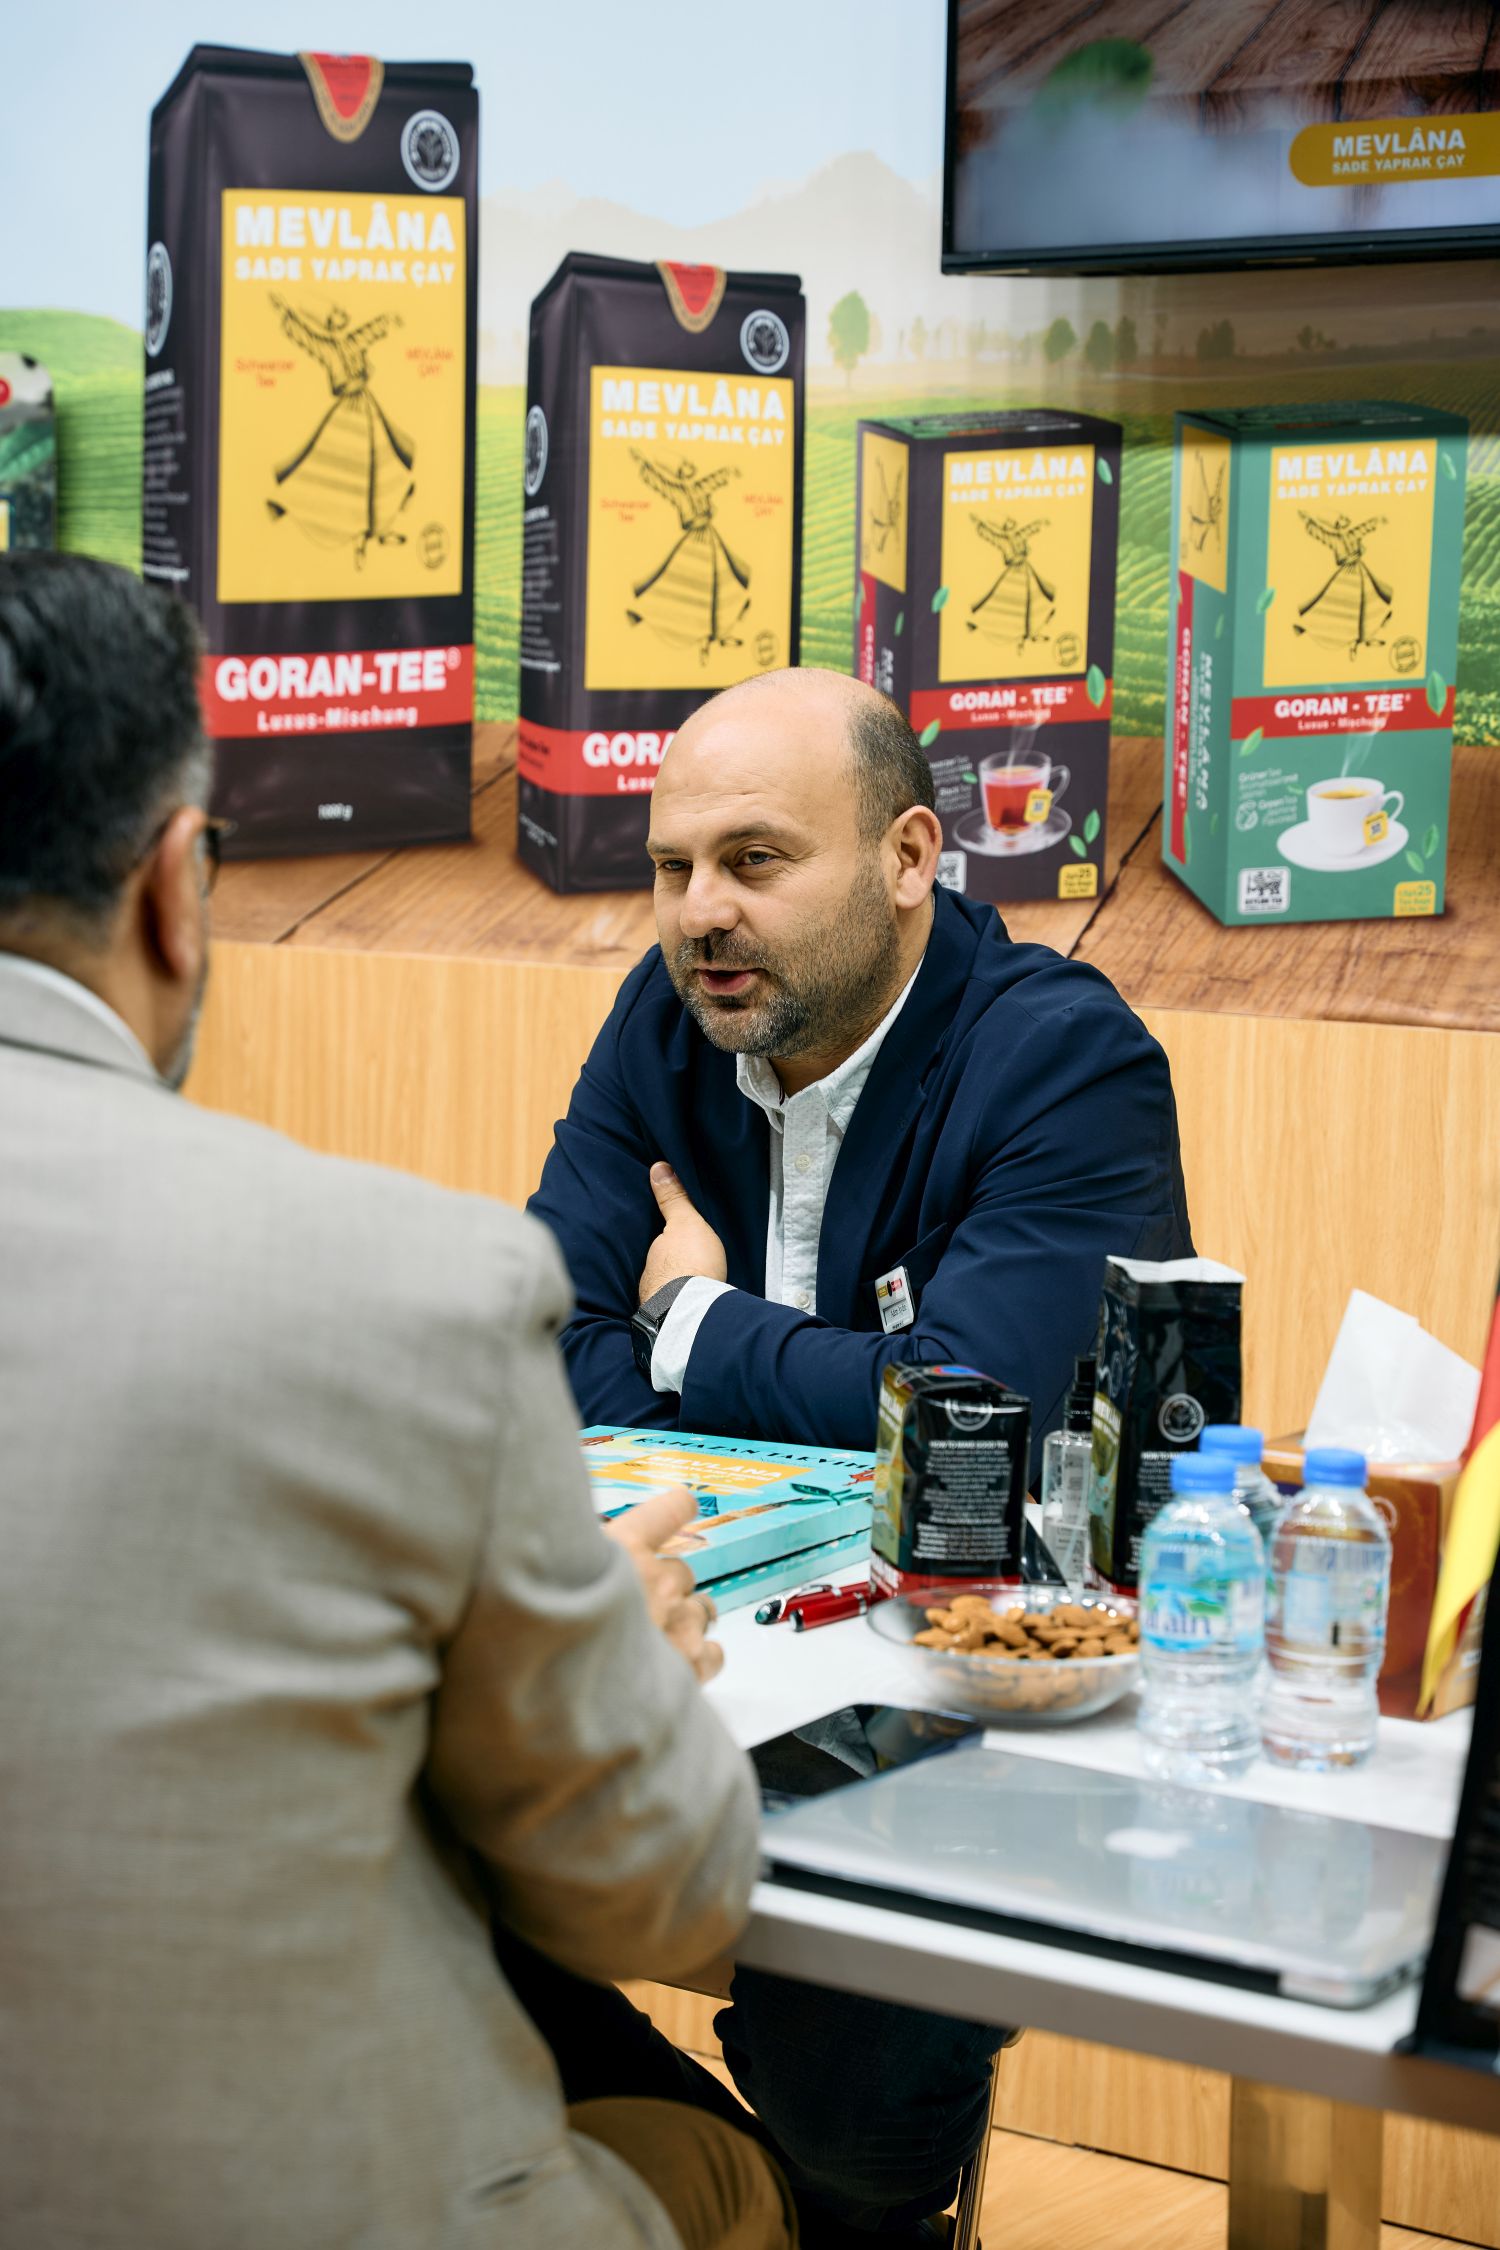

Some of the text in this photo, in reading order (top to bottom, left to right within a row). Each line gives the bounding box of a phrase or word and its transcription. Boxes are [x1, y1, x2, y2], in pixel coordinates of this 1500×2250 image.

[1333, 127, 1465, 158] MEVLÂNA
[1332, 154, 1465, 175] SADE YAPRAK ÇAY
[234, 202, 455, 252] MEVLÂNA
[234, 257, 455, 288] SADE YAPRAK ÇAY
[601, 379, 785, 421] MEVLÂNA
[601, 420, 784, 447] SADE YAPRAK ÇAY
[949, 453, 1086, 485] MEVLÂNA
[1278, 447, 1428, 481] MEVLÂNA
[1278, 479, 1427, 499] SADE YAPRAK ÇAY
[950, 689, 1016, 711] GORAN
[1275, 697, 1348, 718] GORAN
[257, 706, 417, 732] Luxus-Mischung
